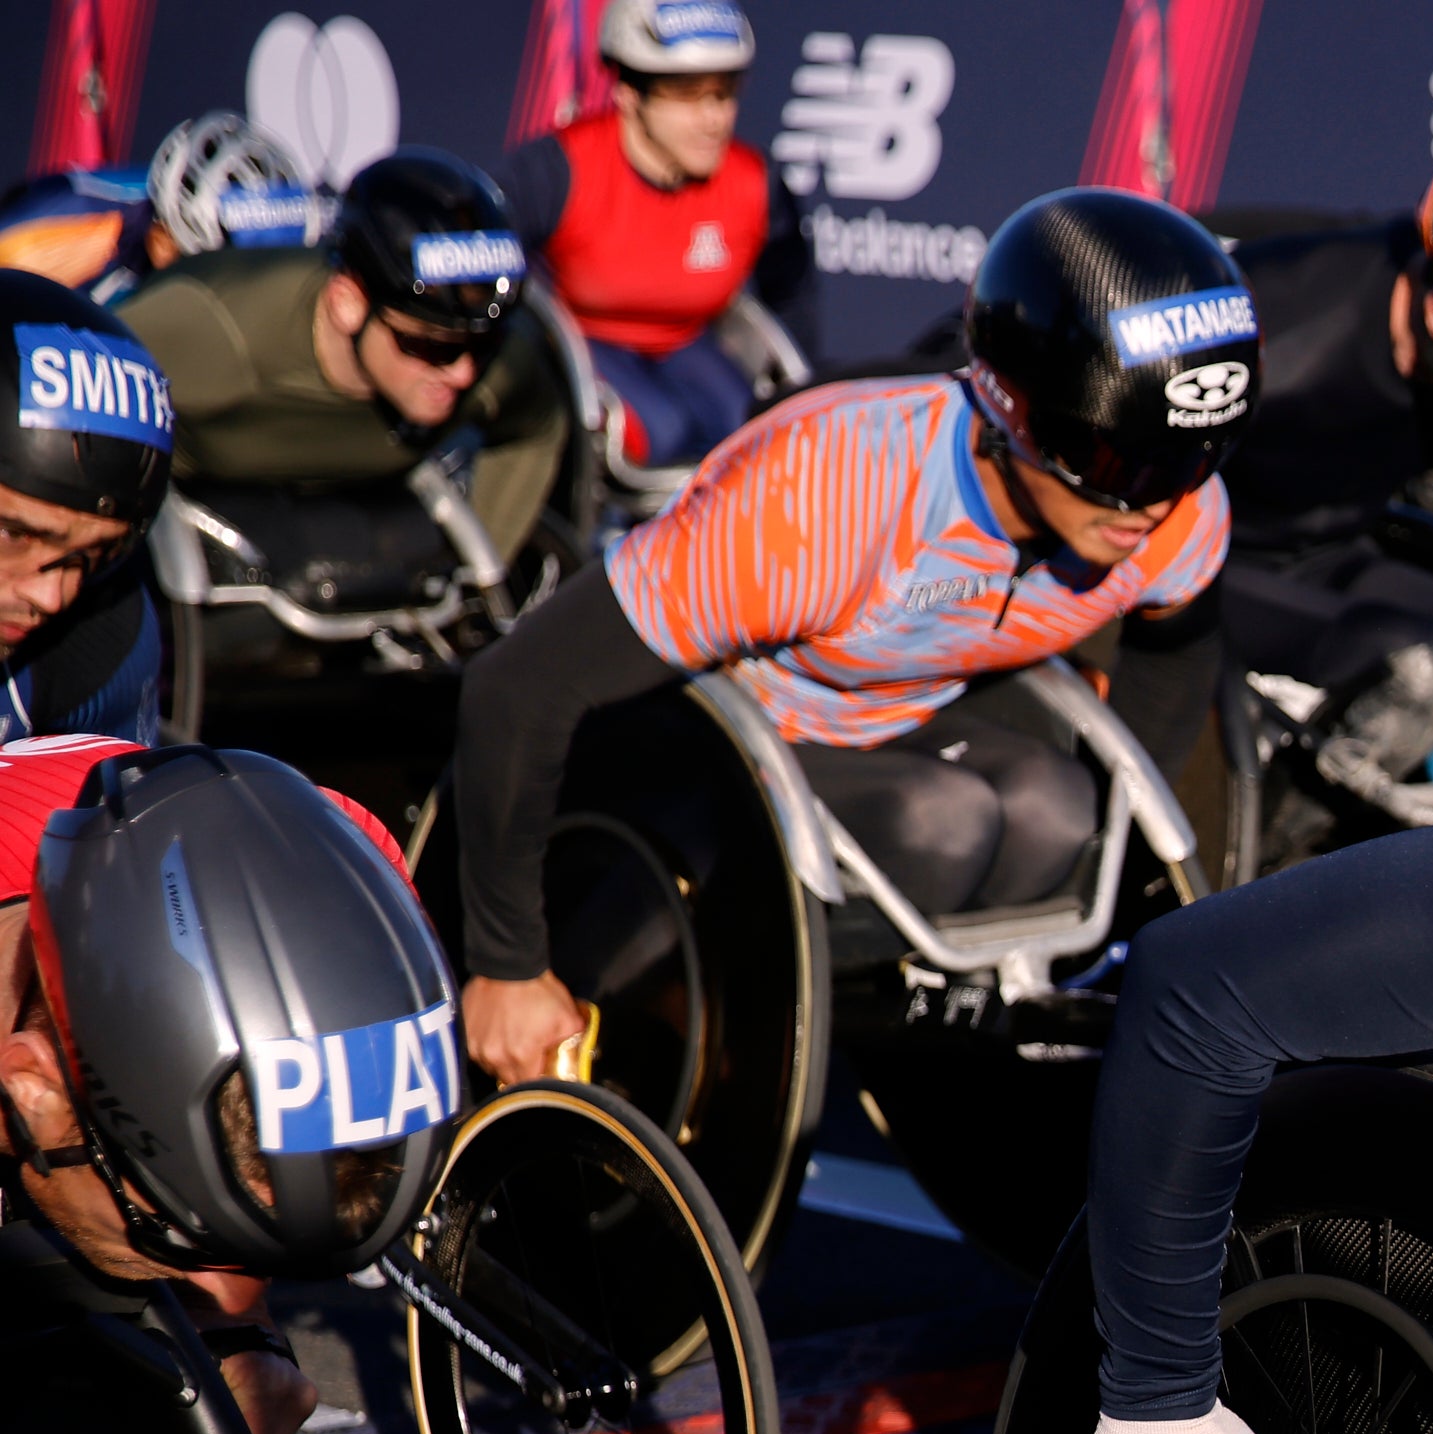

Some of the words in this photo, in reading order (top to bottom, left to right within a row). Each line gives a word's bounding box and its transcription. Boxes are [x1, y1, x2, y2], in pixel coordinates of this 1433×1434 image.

[1118, 295, 1257, 356] WATANABE
[31, 345, 175, 433] SMITH
[254, 1001, 461, 1150] PLAT
